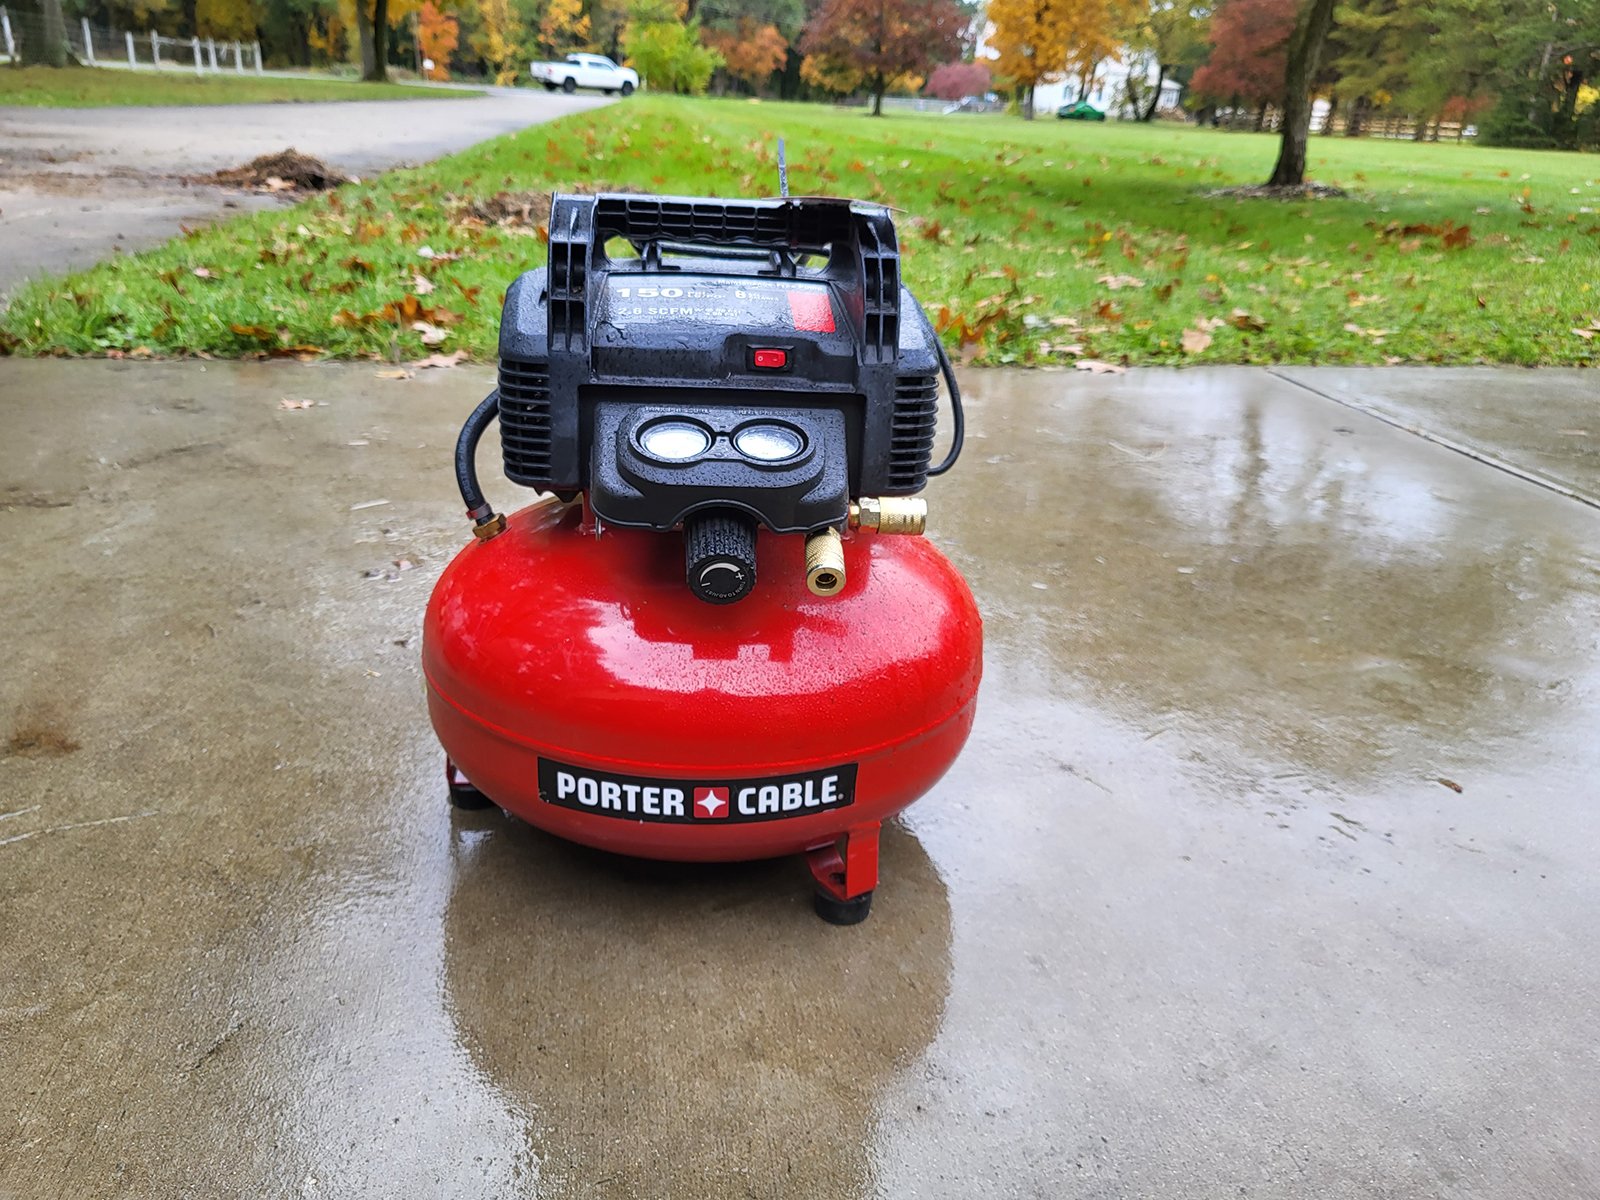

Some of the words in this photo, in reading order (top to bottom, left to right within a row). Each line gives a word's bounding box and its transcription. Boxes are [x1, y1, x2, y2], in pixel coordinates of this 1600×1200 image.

[616, 287, 684, 298] 150
[648, 307, 693, 315] SCFM
[556, 771, 685, 817] PORTER
[737, 774, 839, 816] CABLE
